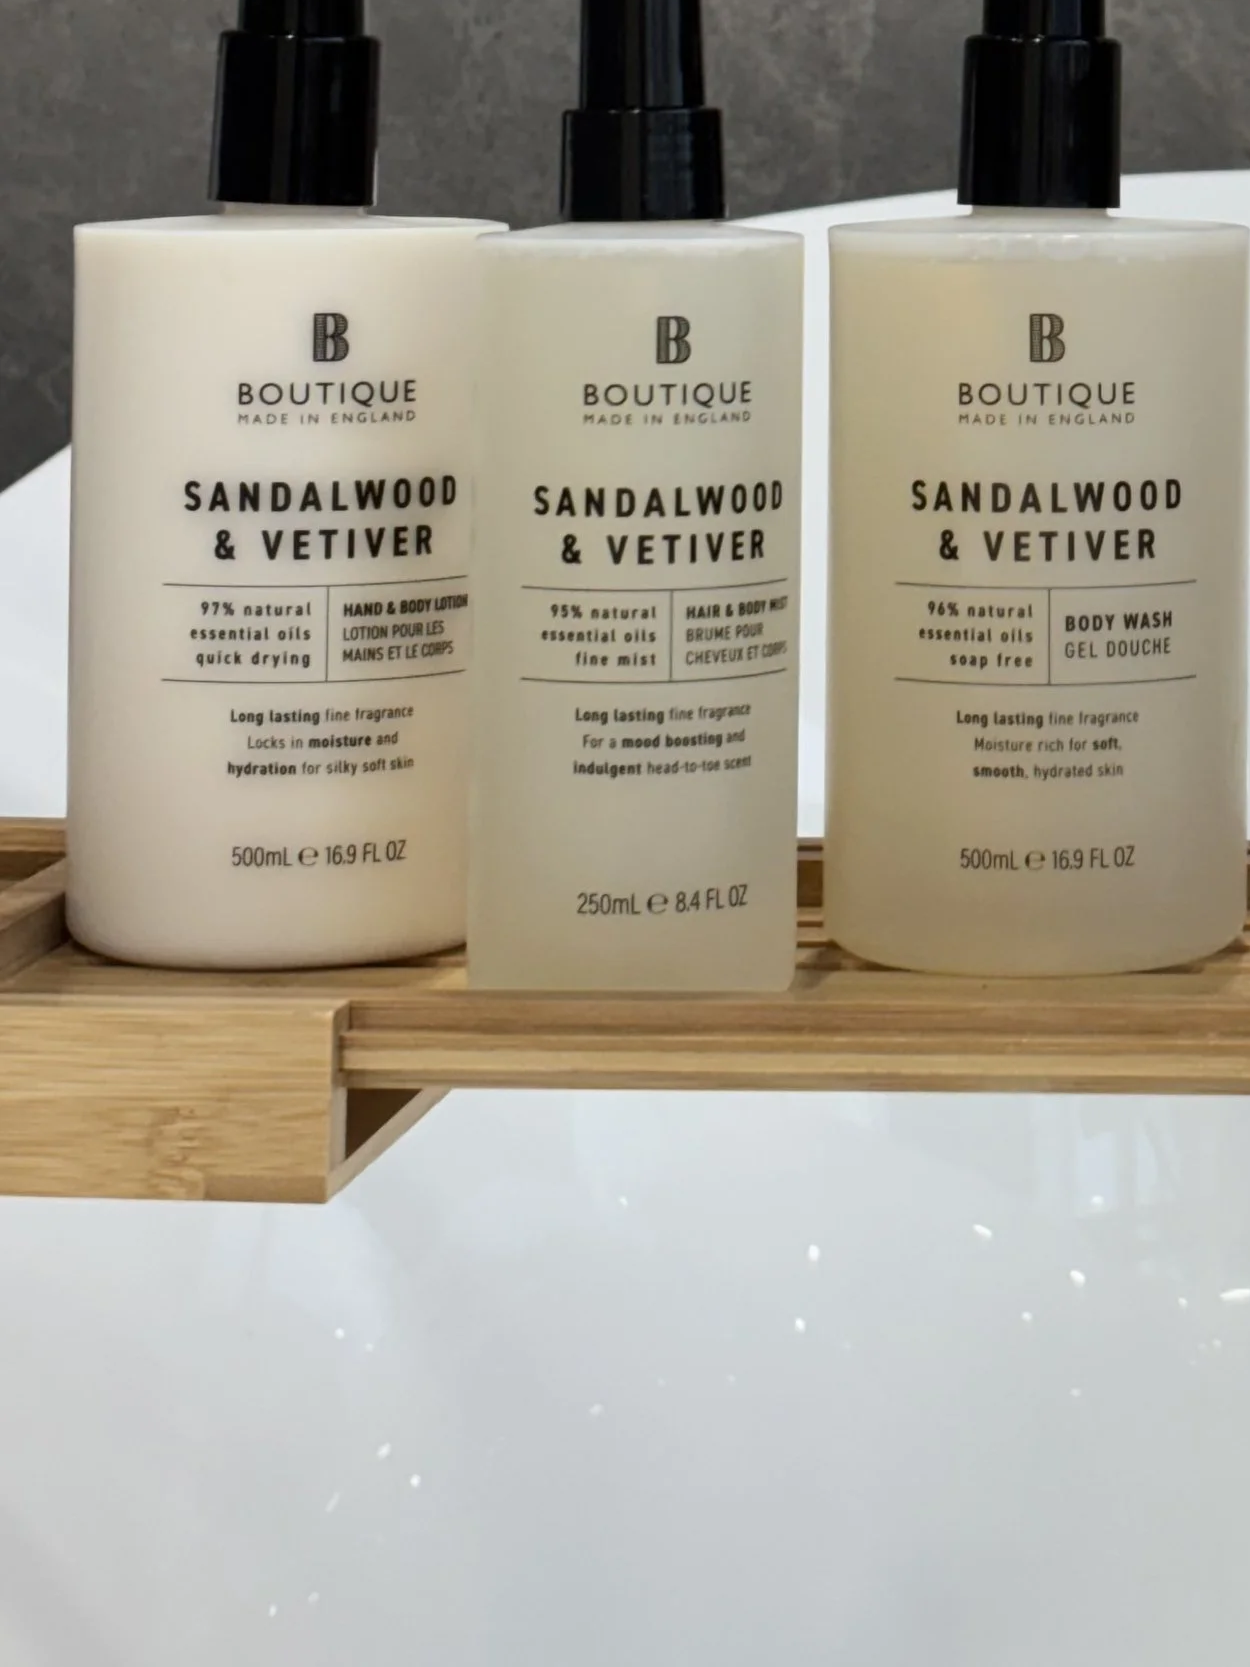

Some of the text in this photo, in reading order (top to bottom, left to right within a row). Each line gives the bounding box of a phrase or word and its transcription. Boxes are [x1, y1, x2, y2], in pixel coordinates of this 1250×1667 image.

[238, 380, 416, 407] BOUTIQUE
[584, 381, 751, 408] BOUTIQUE
[959, 382, 1135, 409] BOUTIQUE
[238, 410, 416, 425] MADE IN ENGLAND
[583, 411, 751, 425] MADE IN ENGLAND
[959, 412, 1134, 425] MADE IN ENGLAND
[184, 475, 456, 512] SANDALWOOD
[534, 480, 782, 518] SANDALWOOD
[912, 479, 1181, 513] SANDALWOOD
[214, 525, 432, 560] & VETIVER
[561, 529, 764, 565] & VETIVER
[939, 529, 1155, 562] & VETIVER
[201, 601, 311, 616] 97% natural
[344, 594, 468, 617] HAND & BODY LOTION
[551, 604, 656, 620] 95% natural
[686, 604, 720, 620] HAIR
[725, 604, 733, 617] &
[738, 600, 766, 617] BODY
[928, 601, 1032, 618] 96% natural
[343, 620, 444, 641] LOTION POUR LES
[1065, 611, 1172, 632] BODY WASH
[190, 626, 311, 641] essential oils
[541, 629, 656, 643] essential oils
[686, 622, 764, 643] BRUME POUR
[919, 628, 1033, 643] essential oils
[343, 647, 383, 662] MAINS
[388, 646, 402, 660] ET
[405, 643, 418, 659] LE
[686, 648, 743, 665] CHEVEUX
[747, 645, 759, 661] ET
[1065, 637, 1170, 659] GEL DOUCHE
[196, 651, 310, 668] quick drying
[576, 651, 656, 666] fine mist
[950, 653, 1032, 670] soap free
[231, 707, 414, 726] Long lasting fine fragrance
[575, 704, 751, 726] Long lasting fine fragrance
[957, 710, 1139, 729] Long lasting fine fragrance
[248, 731, 398, 750] Locks in moisture and
[583, 729, 745, 749] For a mood boosting and
[974, 737, 1032, 752] Moisture
[1038, 738, 1064, 752] rich
[1069, 738, 1087, 752] for
[227, 757, 414, 778] hydration for silky soft skin
[573, 755, 751, 779] indulgent head-to-toe scent
[1034, 764, 1093, 781] hydrated
[1097, 763, 1123, 777] skin
[232, 846, 292, 868] 500mL
[326, 844, 356, 865] 16.9
[362, 842, 381, 863] FL
[385, 839, 406, 862] OZ
[960, 848, 1019, 870] 500mL
[1052, 849, 1083, 870] 16.9
[1090, 848, 1109, 869] FL
[1114, 845, 1135, 867] OZ
[577, 892, 641, 915] 250mL
[675, 890, 700, 913] 8.4
[706, 888, 724, 910] FL
[728, 884, 748, 907] OZ
